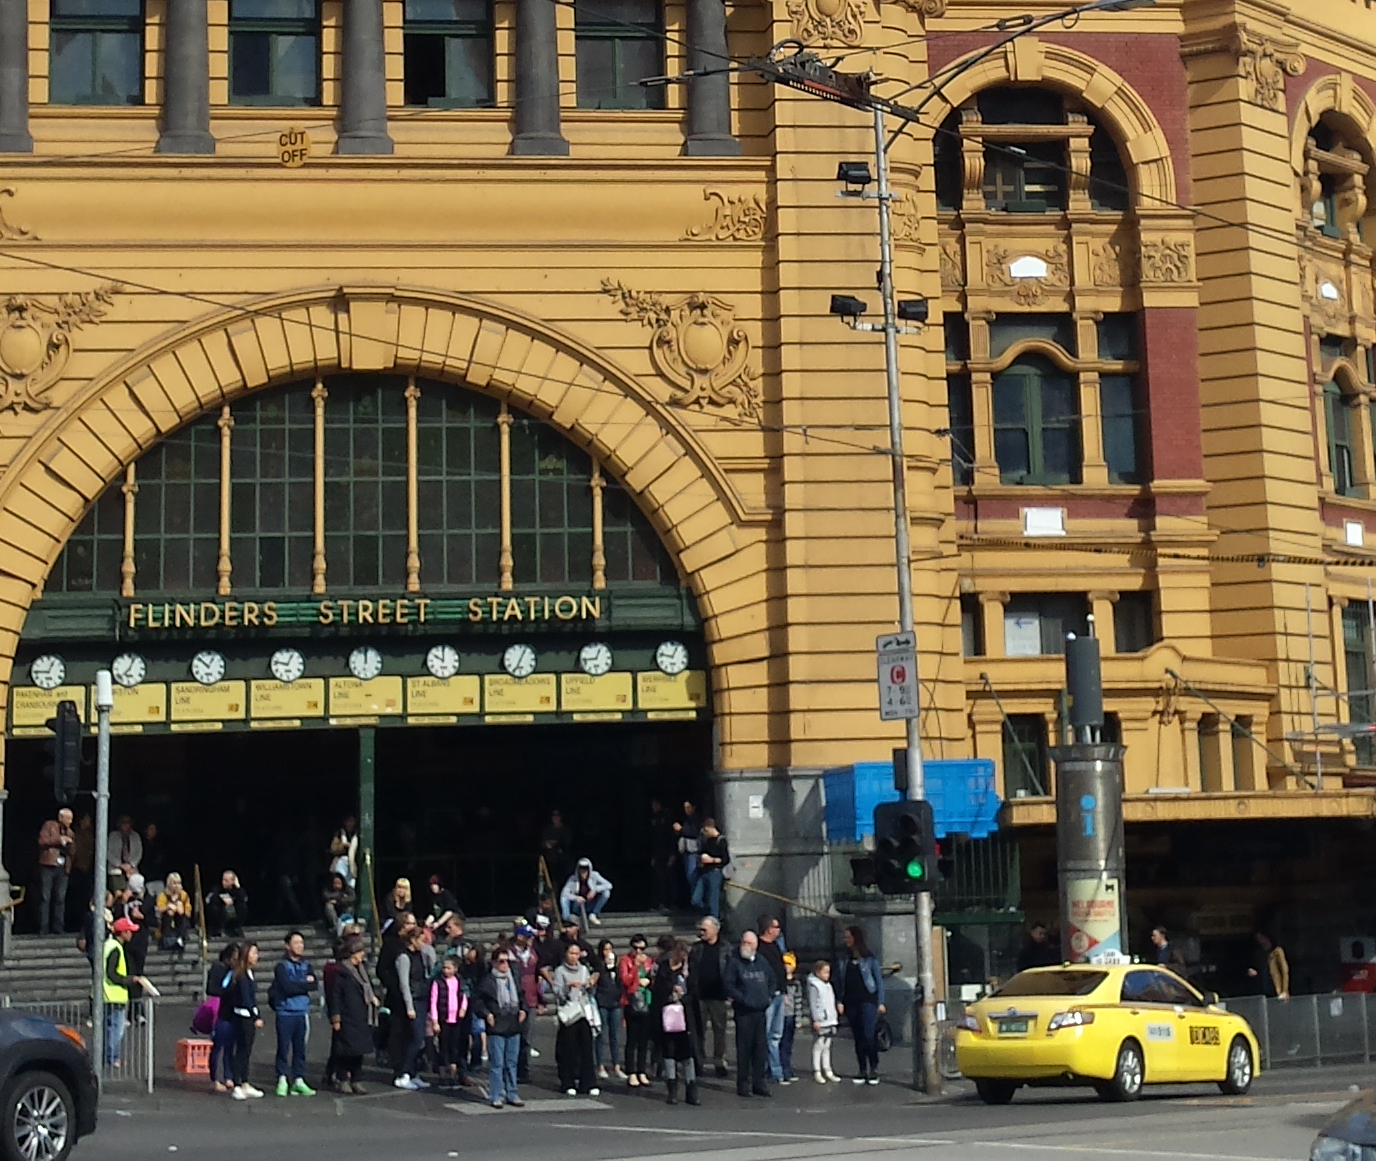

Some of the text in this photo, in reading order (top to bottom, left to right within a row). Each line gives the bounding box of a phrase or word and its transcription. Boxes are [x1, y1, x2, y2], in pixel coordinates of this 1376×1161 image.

[279, 130, 306, 147] CUT
[281, 148, 308, 163] OFF
[127, 595, 602, 628] FLINDERS STREET STATION
